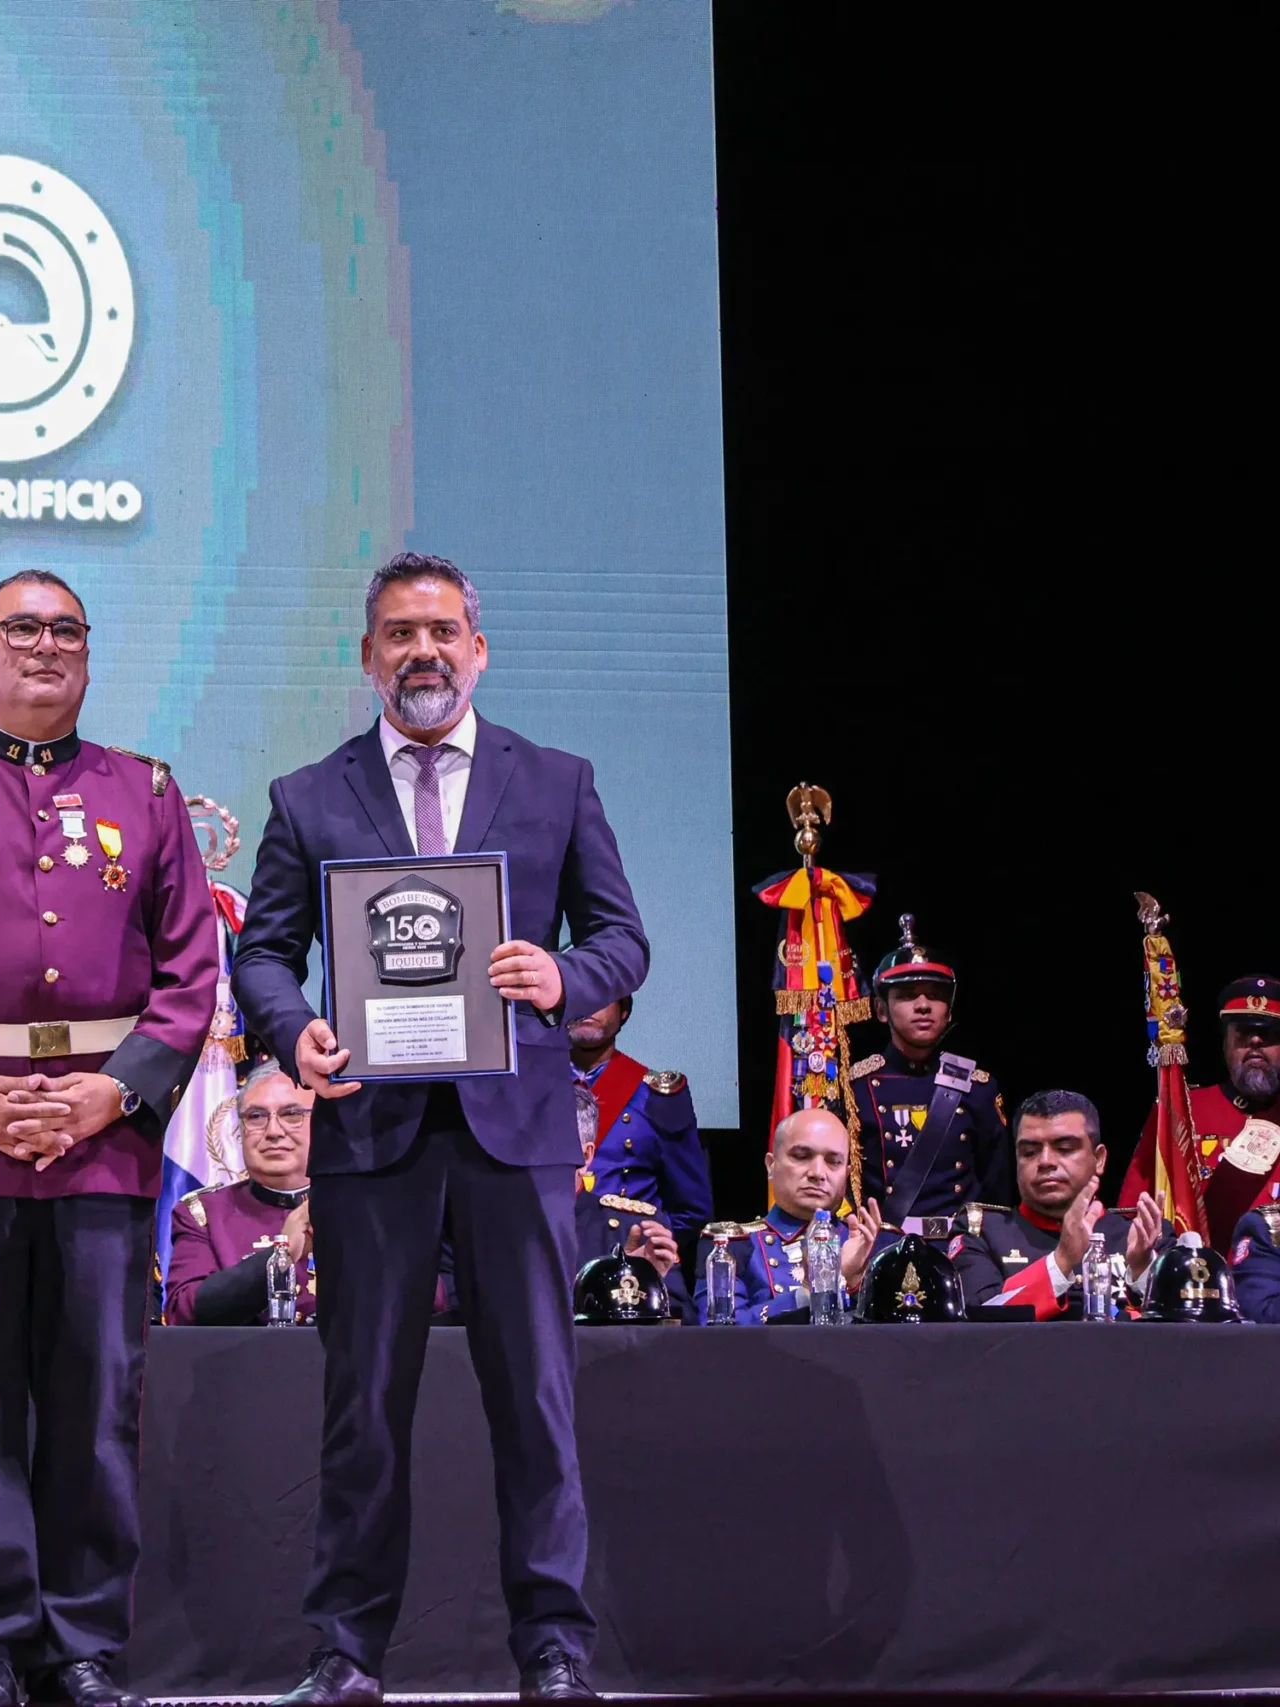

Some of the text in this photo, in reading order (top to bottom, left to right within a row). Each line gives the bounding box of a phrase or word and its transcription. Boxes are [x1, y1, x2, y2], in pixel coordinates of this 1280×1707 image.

[382, 893, 443, 909] BOMBEROS
[386, 914, 441, 941] 150
[391, 955, 439, 968] IQUIQUE
